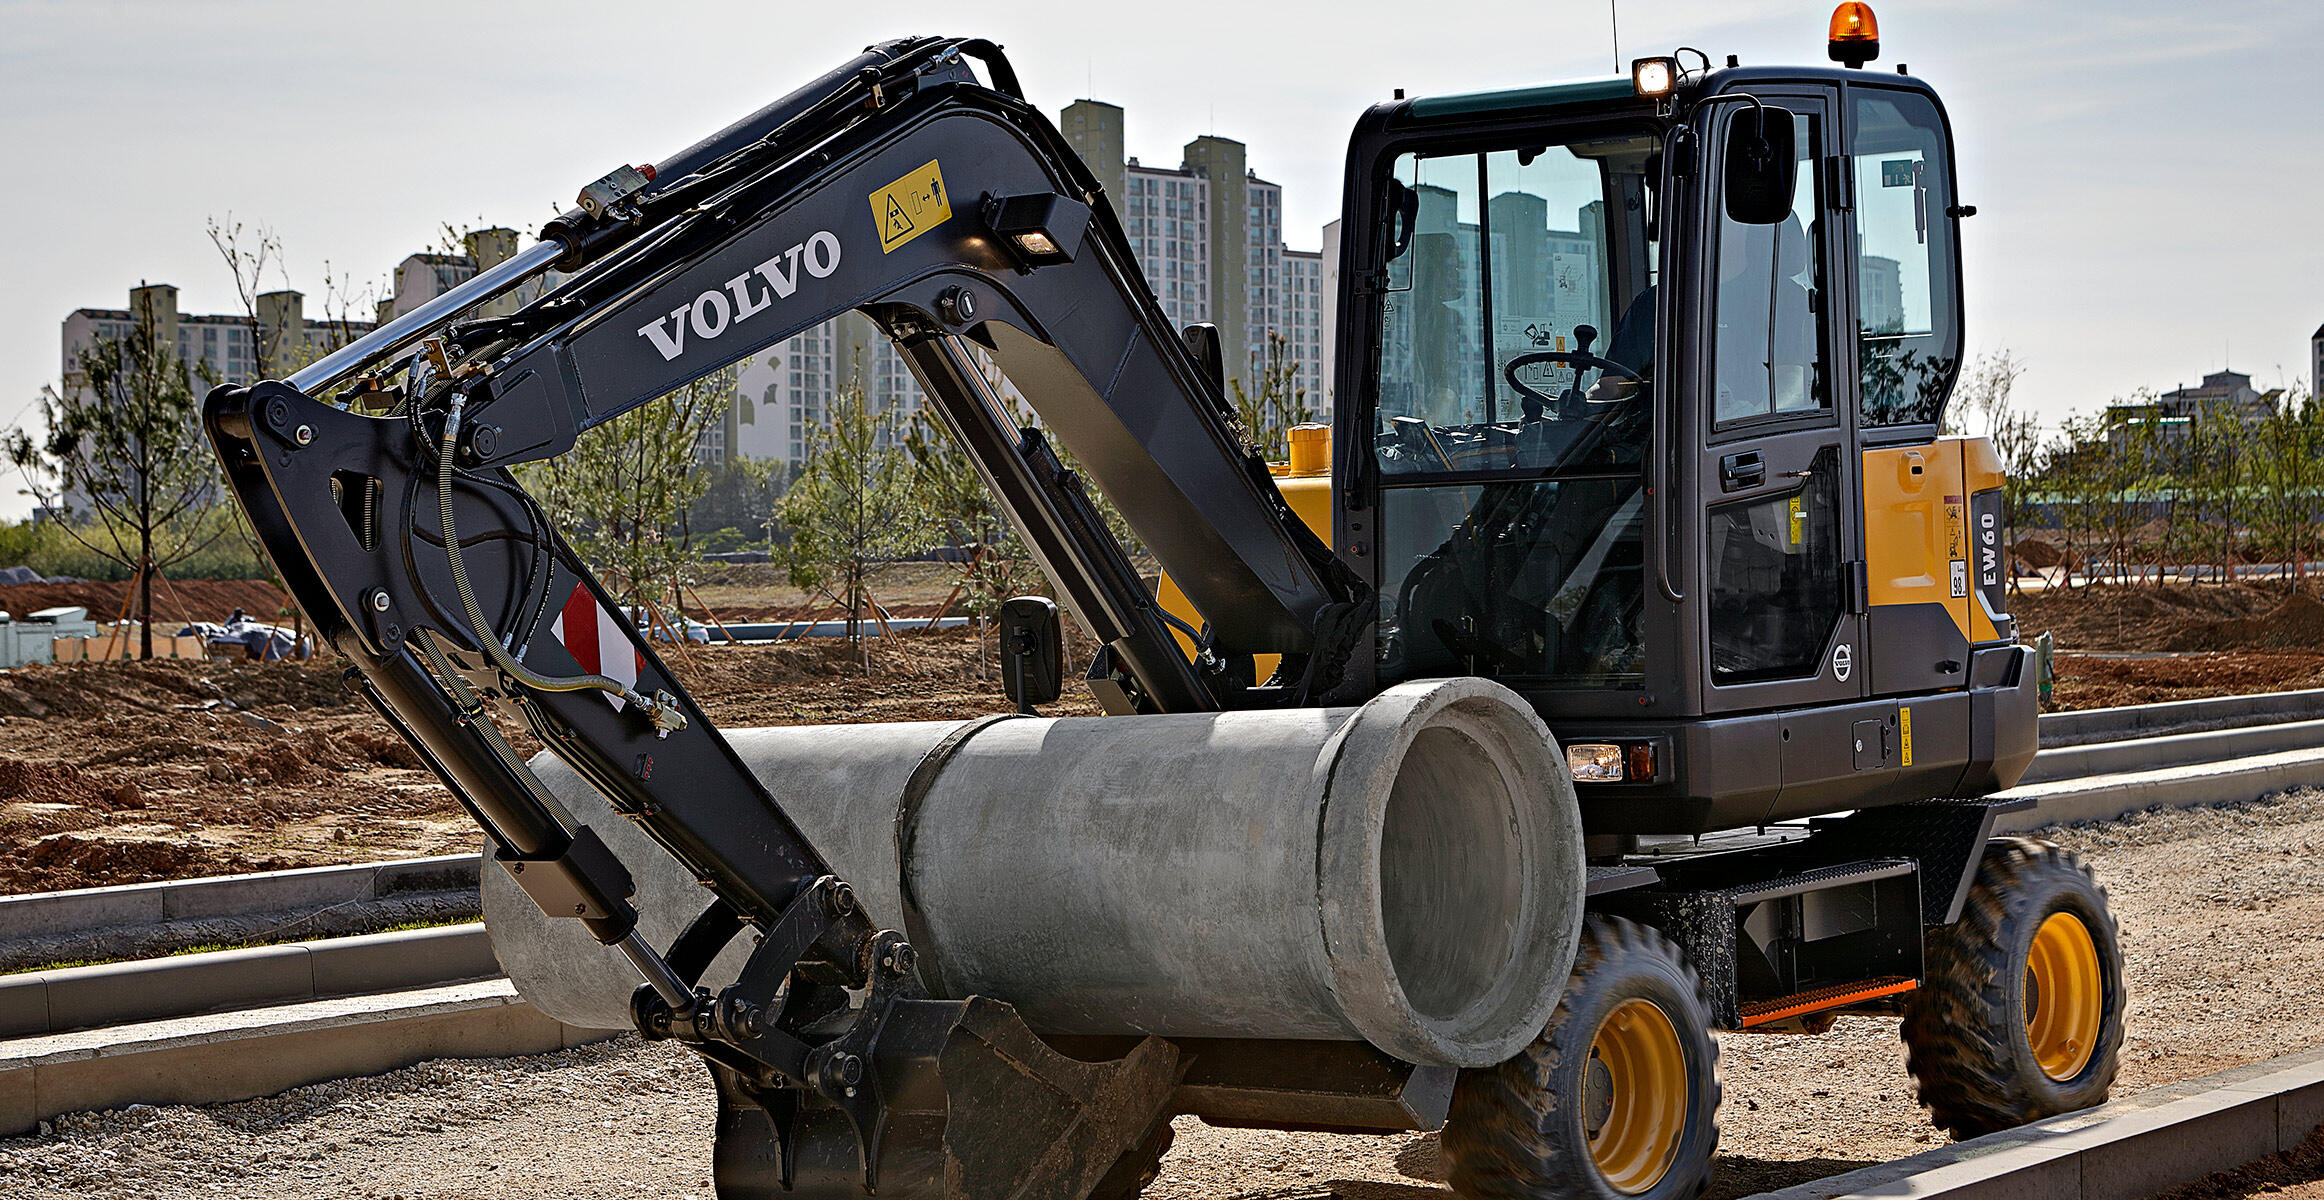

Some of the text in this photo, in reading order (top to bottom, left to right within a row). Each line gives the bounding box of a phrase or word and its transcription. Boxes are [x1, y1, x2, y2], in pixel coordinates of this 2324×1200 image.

[638, 230, 841, 361] VOLVO
[1953, 576, 1962, 595] 98
[1981, 513, 1996, 586] EW60
